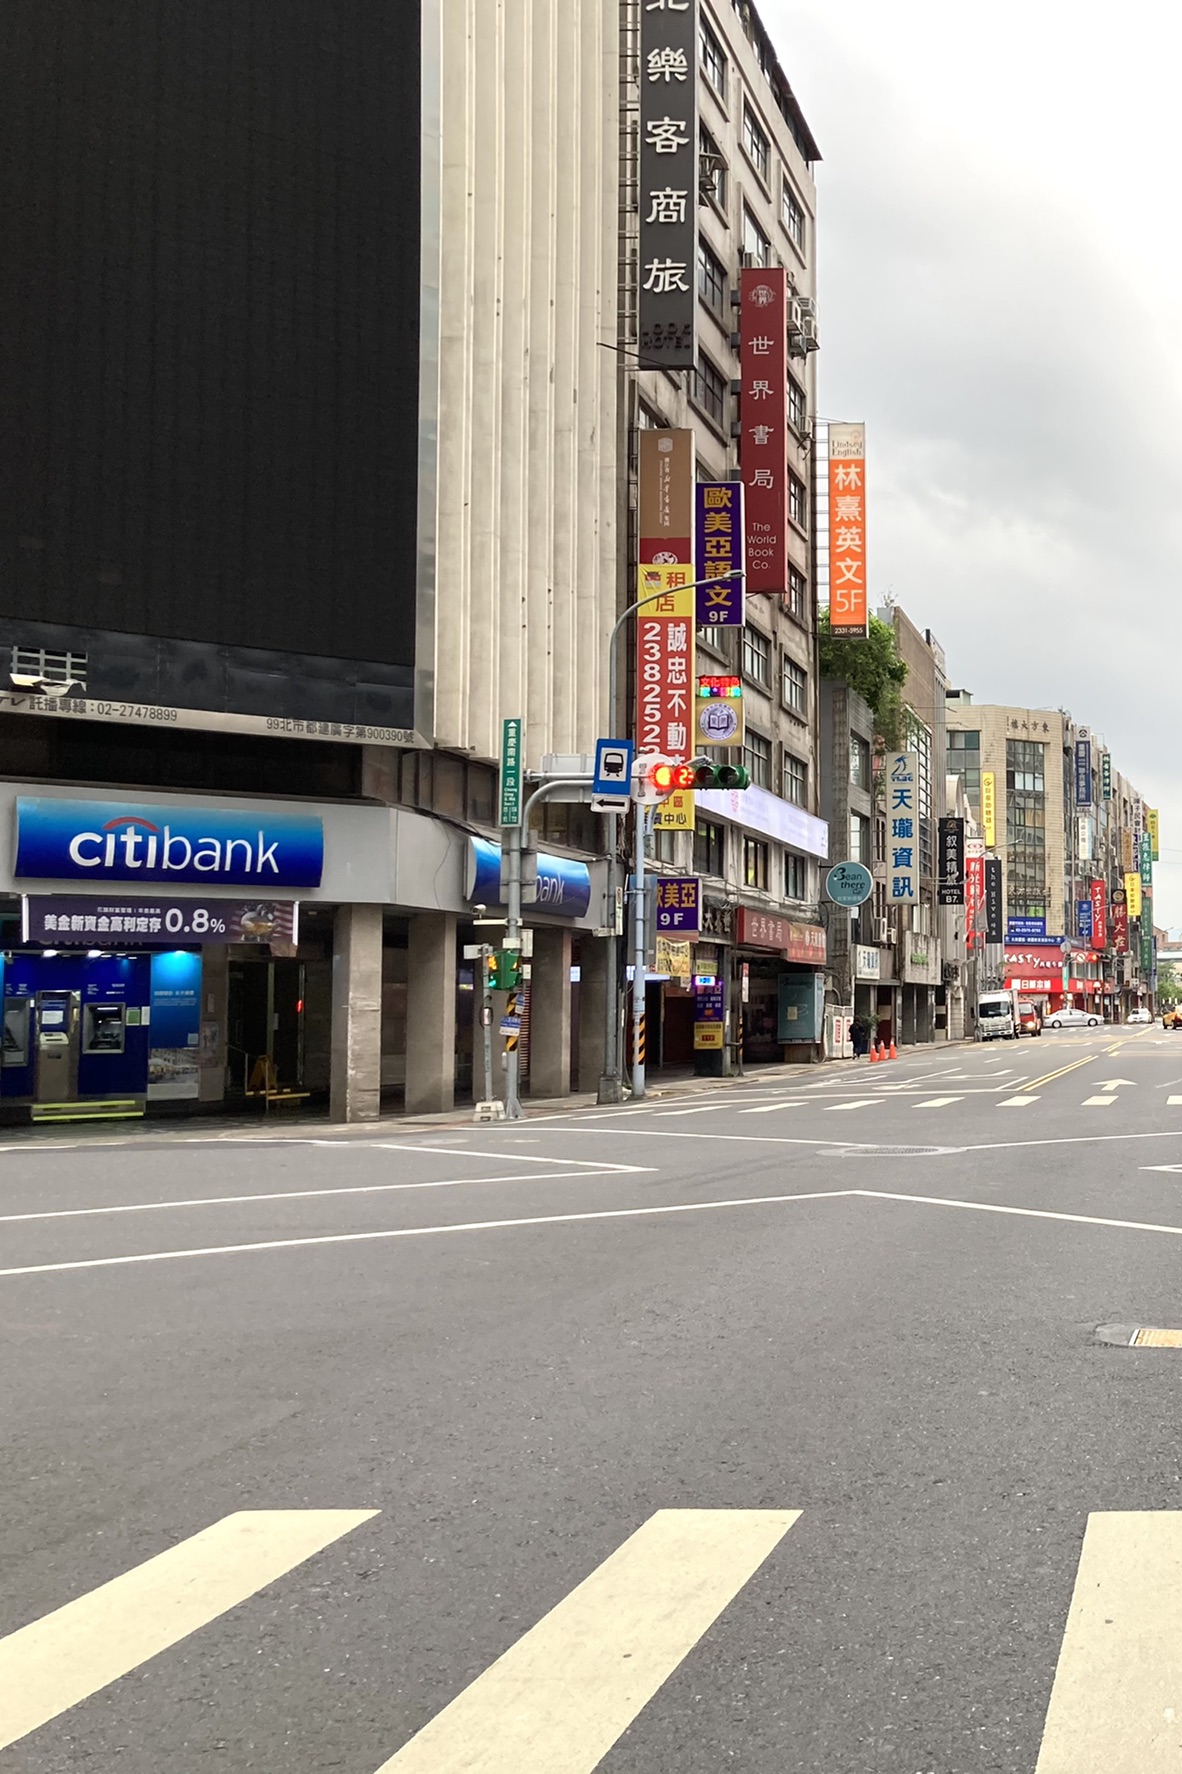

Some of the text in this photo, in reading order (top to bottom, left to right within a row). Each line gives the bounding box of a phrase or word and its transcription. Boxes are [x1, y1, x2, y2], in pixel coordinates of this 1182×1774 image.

[748, 335, 775, 489] 世界書局
[752, 521, 771, 532] The
[834, 464, 862, 586] 林熹英文
[747, 534, 777, 545] World
[748, 547, 774, 558] Book
[752, 560, 771, 570] Co.
[836, 590, 864, 613] 5F
[708, 611, 729, 622] 9F
[69, 825, 280, 874] citibank
[892, 789, 914, 898] 天瓏資訊
[1094, 886, 1102, 922] TASTY
[44, 908, 226, 933] 美金新資金高利定存 0.8%
[660, 913, 684, 925] 9F
[1003, 953, 1040, 968] TASTY
